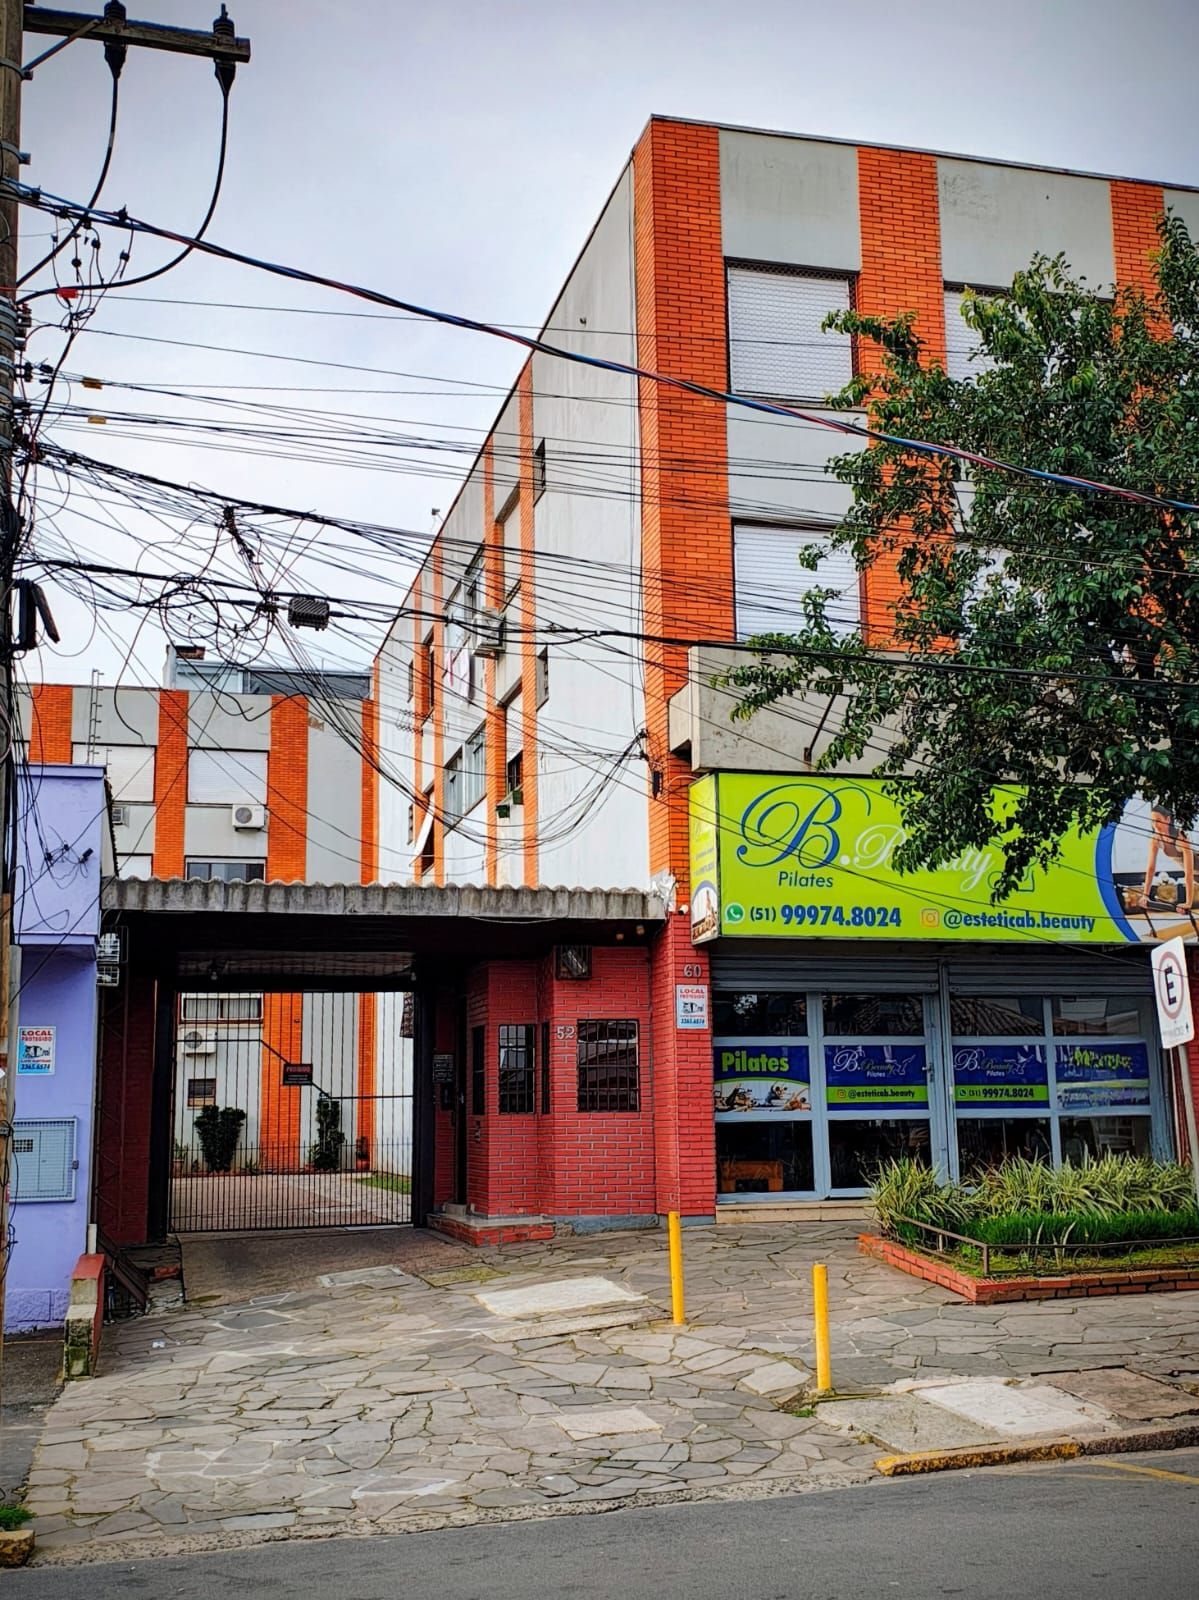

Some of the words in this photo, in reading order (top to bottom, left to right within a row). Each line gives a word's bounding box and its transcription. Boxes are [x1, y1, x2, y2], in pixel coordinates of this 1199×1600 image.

[778, 871, 834, 888] Pilates
[750, 907, 777, 922] (51)
[781, 905, 902, 927] 99974.8024
[943, 909, 1096, 933] @esteticab.beauty
[684, 964, 702, 978] 60
[1164, 965, 1177, 1006] E
[556, 1026, 576, 1040] 52
[721, 1050, 789, 1072] Pilates
[866, 1070, 886, 1078] Pilates
[848, 1088, 915, 1099] @esteticab.beauty
[982, 1087, 1034, 1098] 99974.8024
